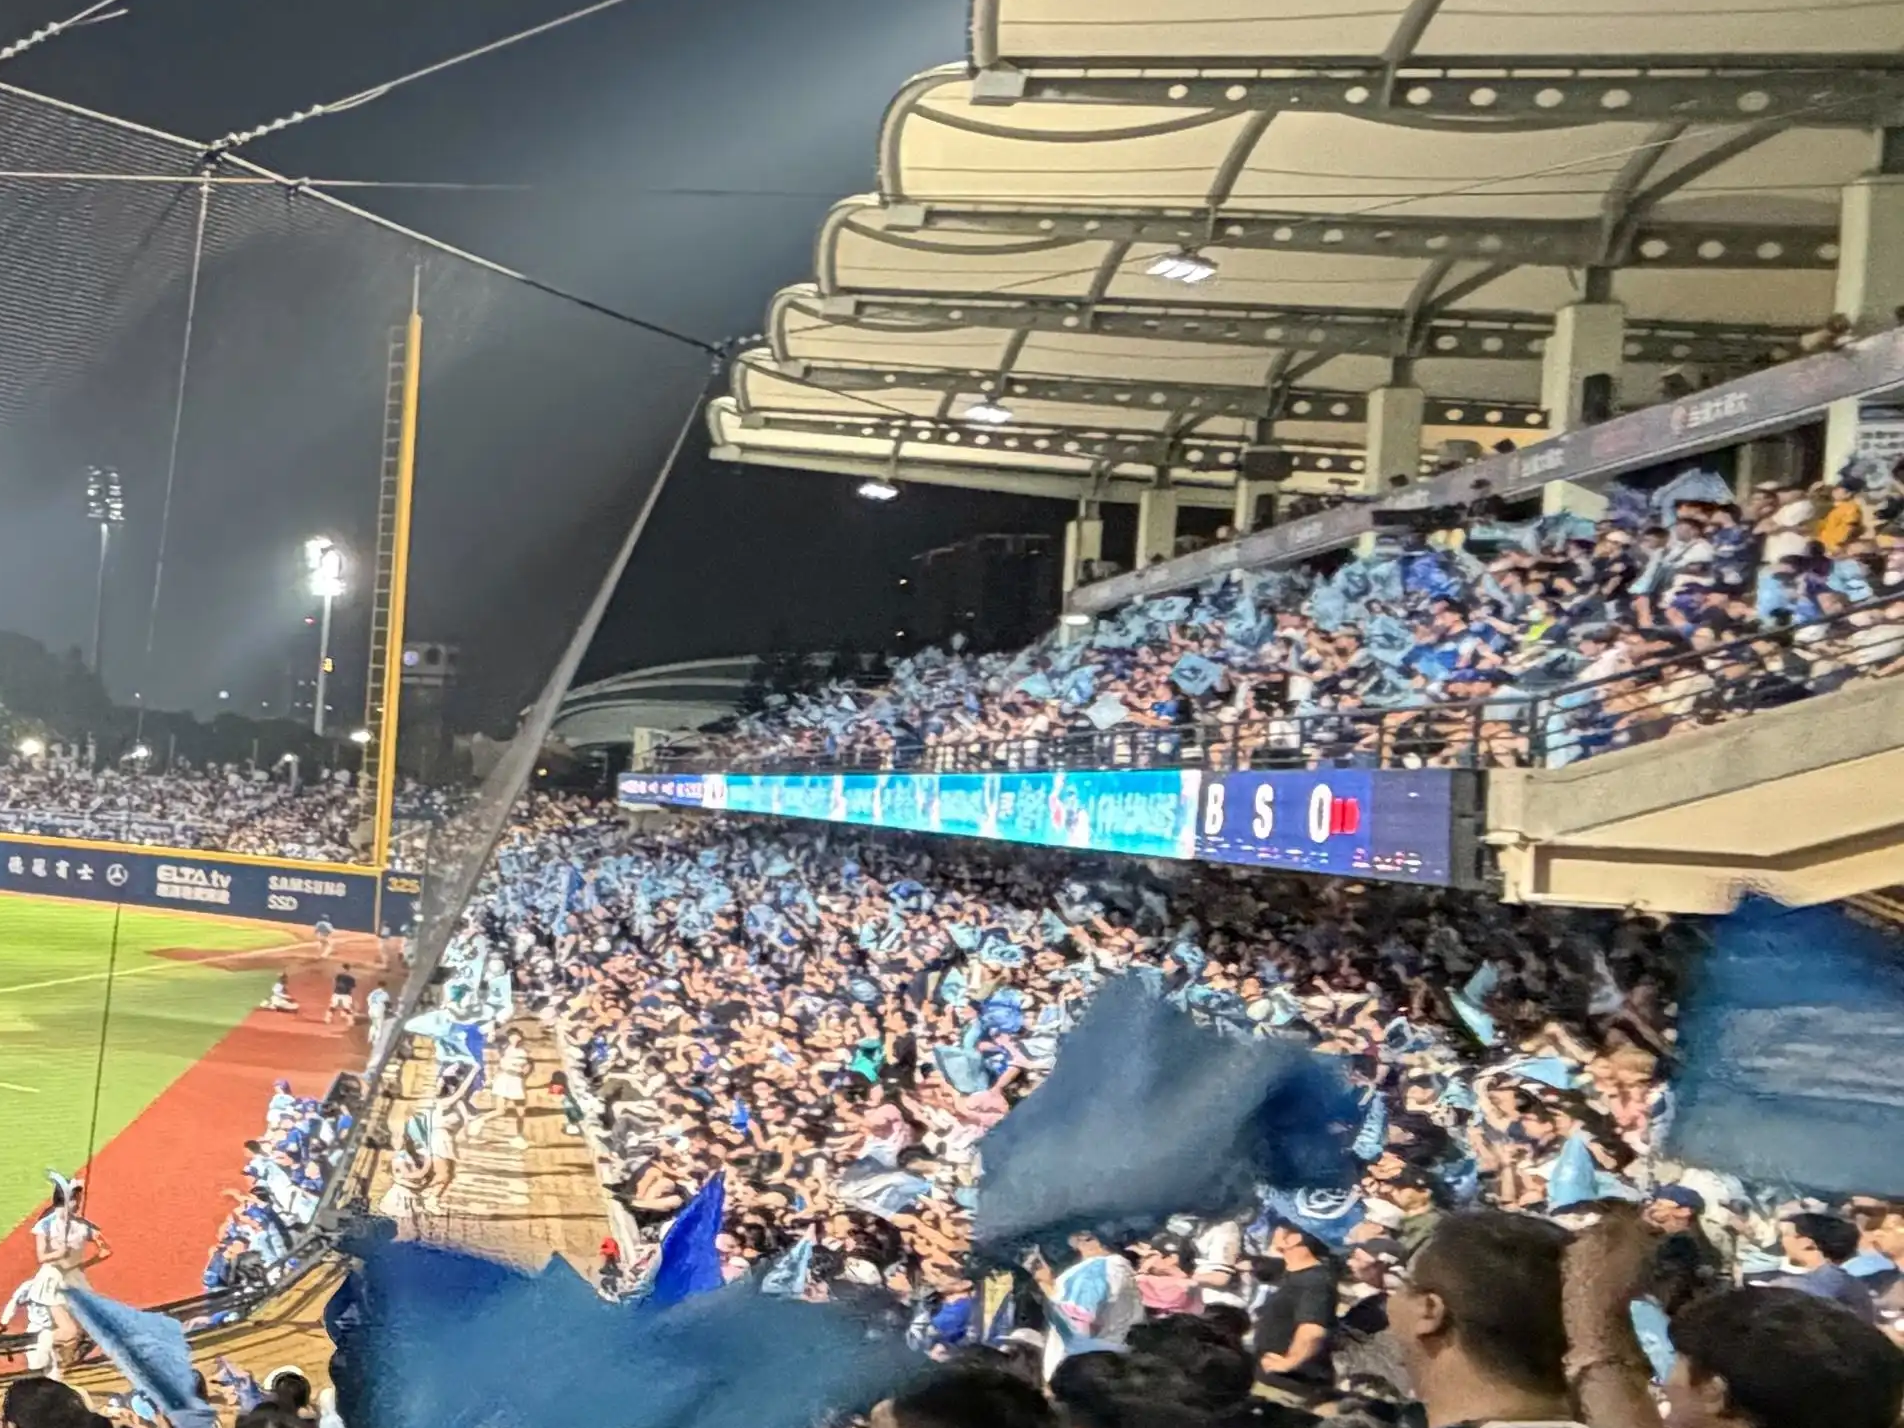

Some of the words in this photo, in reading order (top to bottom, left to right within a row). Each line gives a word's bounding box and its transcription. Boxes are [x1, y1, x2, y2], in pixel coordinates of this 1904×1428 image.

[1204, 783, 1225, 835] B
[1252, 784, 1275, 839] S
[209, 868, 231, 889] tv
[268, 875, 345, 897] SAMSUNG
[387, 876, 420, 893] 325
[267, 894, 298, 911] SSD
